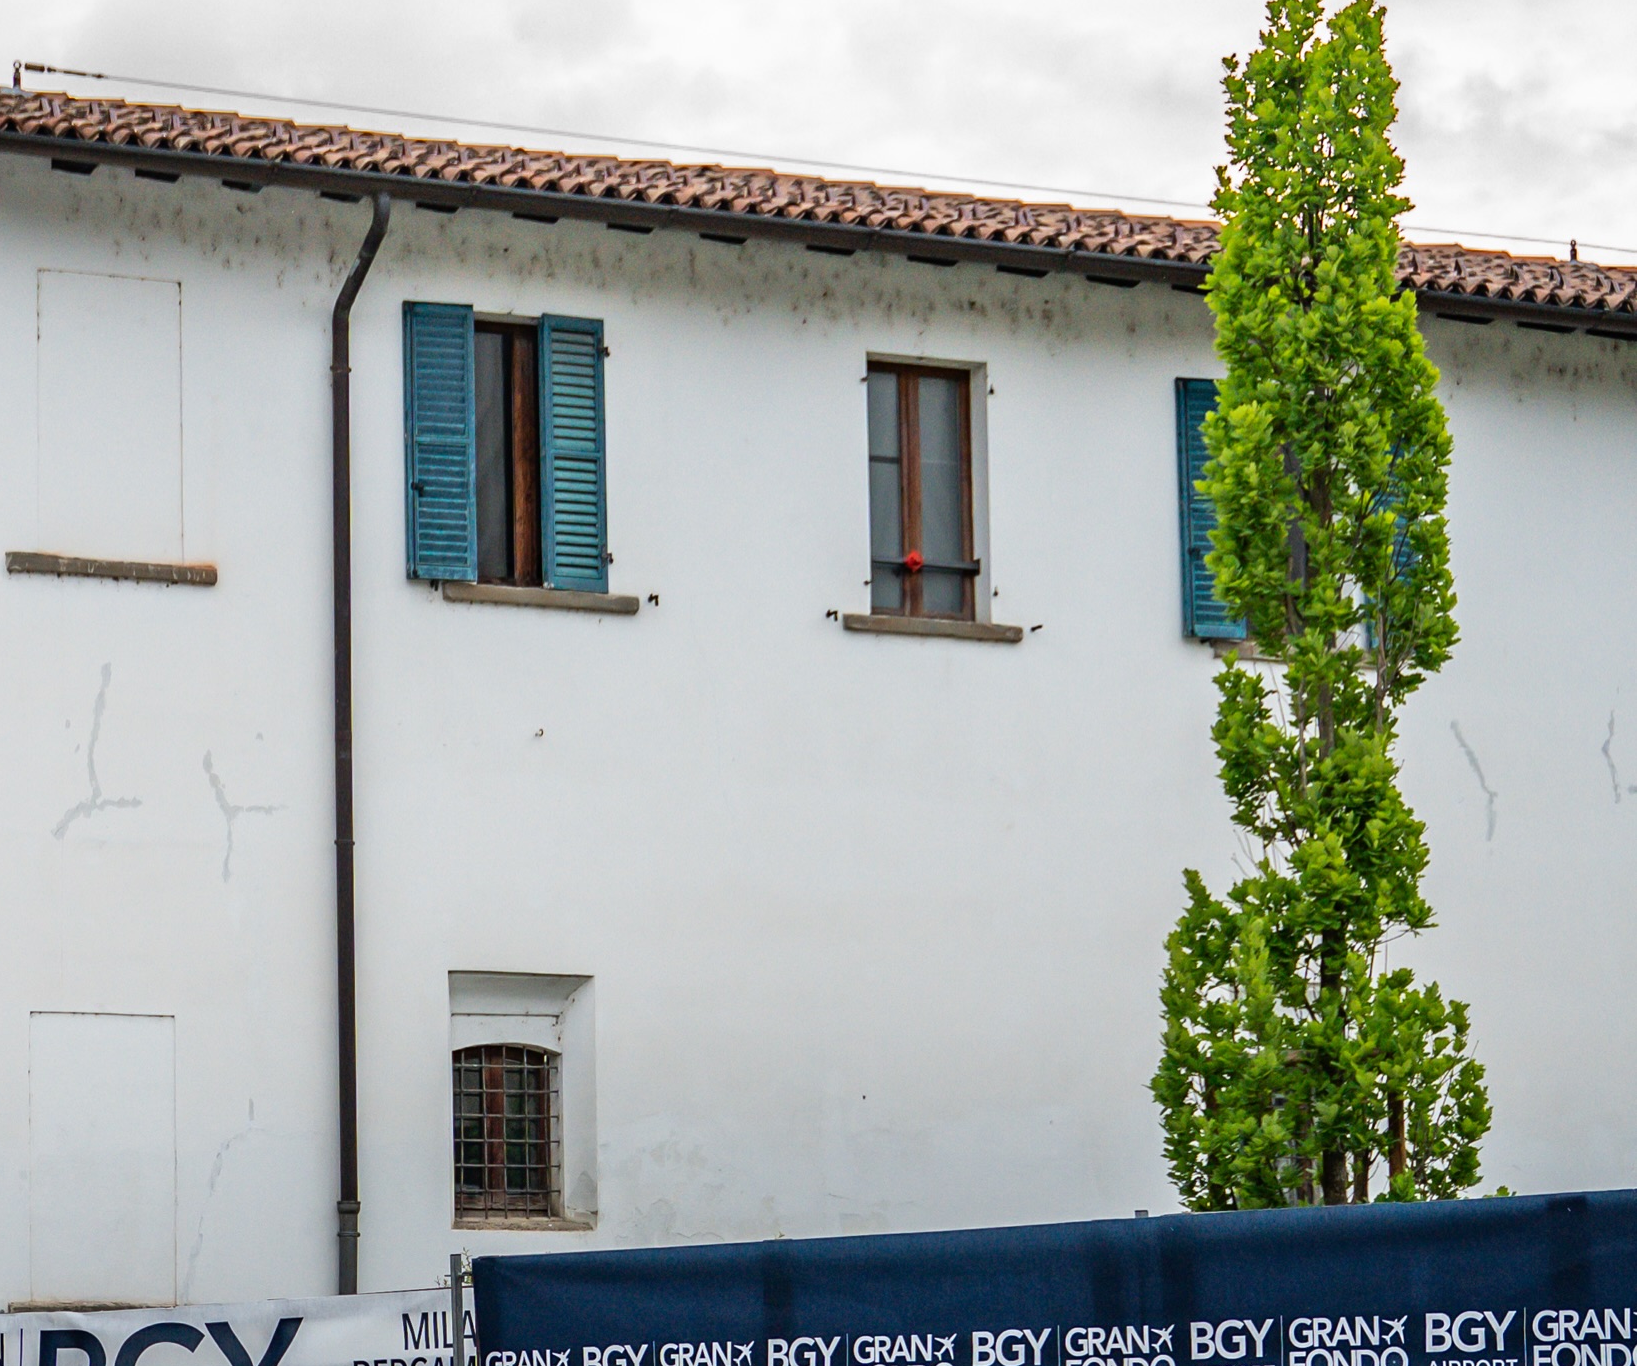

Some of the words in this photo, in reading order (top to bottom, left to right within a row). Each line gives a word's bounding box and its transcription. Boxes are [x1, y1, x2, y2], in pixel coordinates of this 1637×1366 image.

[1065, 1325, 1150, 1356] GRAN
[1190, 1318, 1274, 1360] BGY
[1289, 1316, 1379, 1348] GRAN
[1425, 1310, 1517, 1353] BGY
[1532, 1308, 1631, 1342] GRAN
[853, 1334, 933, 1363] GRAN
